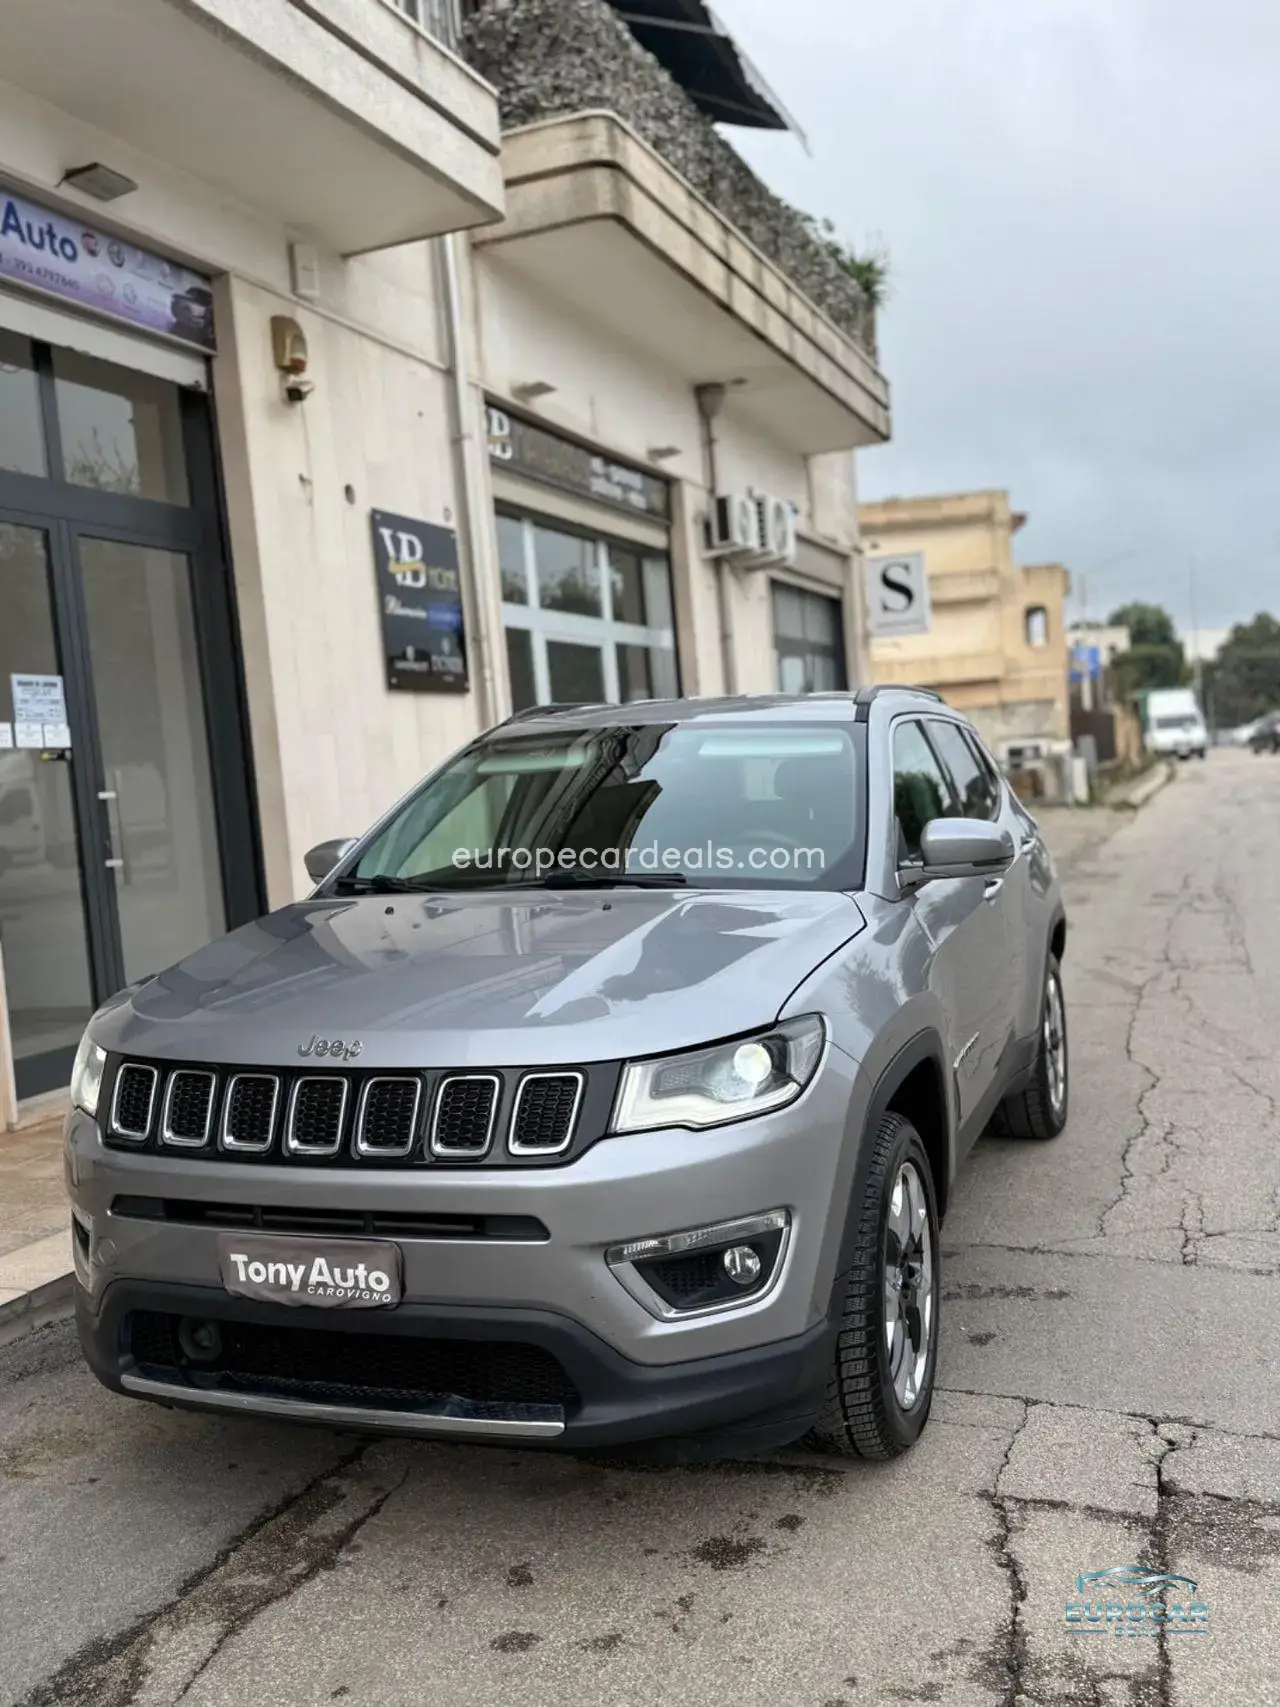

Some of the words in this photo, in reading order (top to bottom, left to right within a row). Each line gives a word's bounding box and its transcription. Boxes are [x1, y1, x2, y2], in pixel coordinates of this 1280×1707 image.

[1, 200, 78, 262] Auto
[882, 562, 914, 613] S
[297, 1035, 363, 1061] Jeep
[230, 1253, 306, 1292] Tony
[308, 1257, 390, 1292] Auto
[307, 1286, 391, 1303] CAROVIGNO
